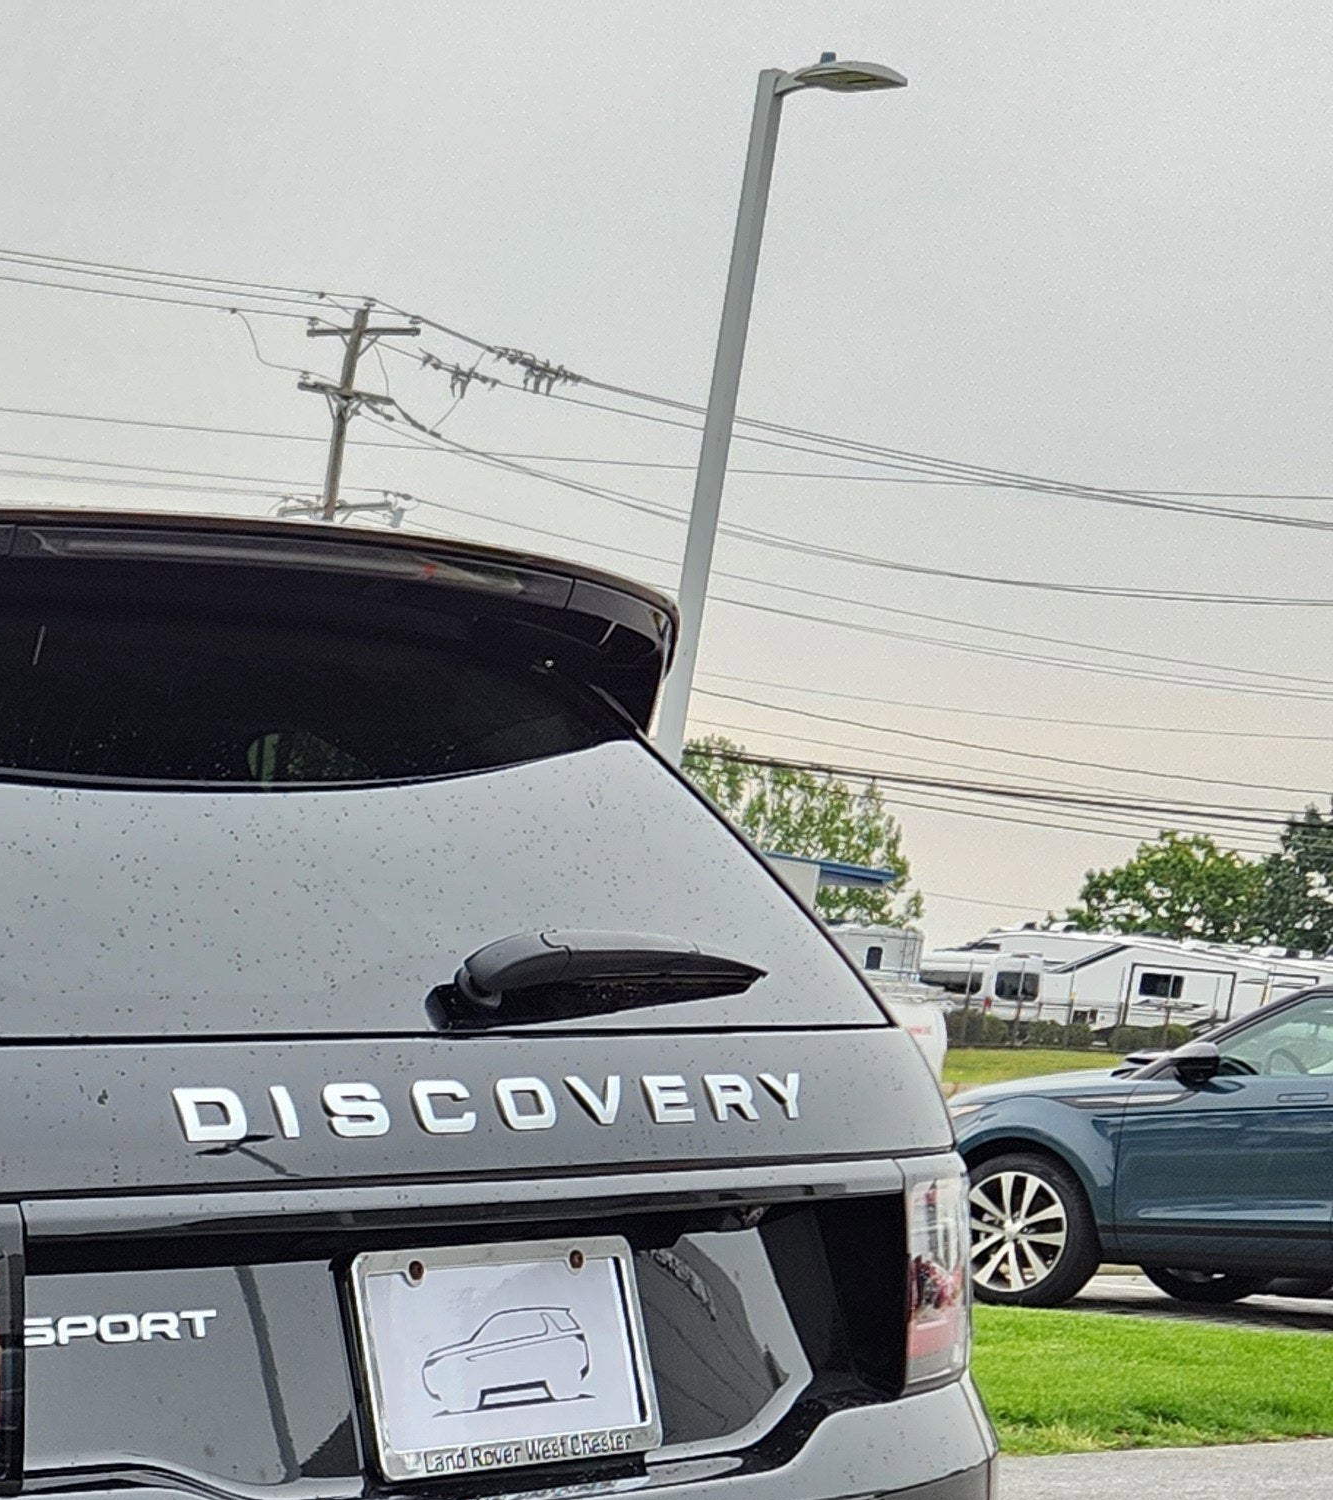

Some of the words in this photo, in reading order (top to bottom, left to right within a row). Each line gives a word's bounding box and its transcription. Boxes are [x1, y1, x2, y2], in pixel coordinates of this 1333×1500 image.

[173, 1073, 800, 1142] DISCOVERY
[23, 1308, 217, 1347] SPORT
[424, 1450, 466, 1474] Land
[471, 1446, 521, 1468] Rover
[526, 1437, 566, 1461] West
[568, 1431, 633, 1456] Chester
